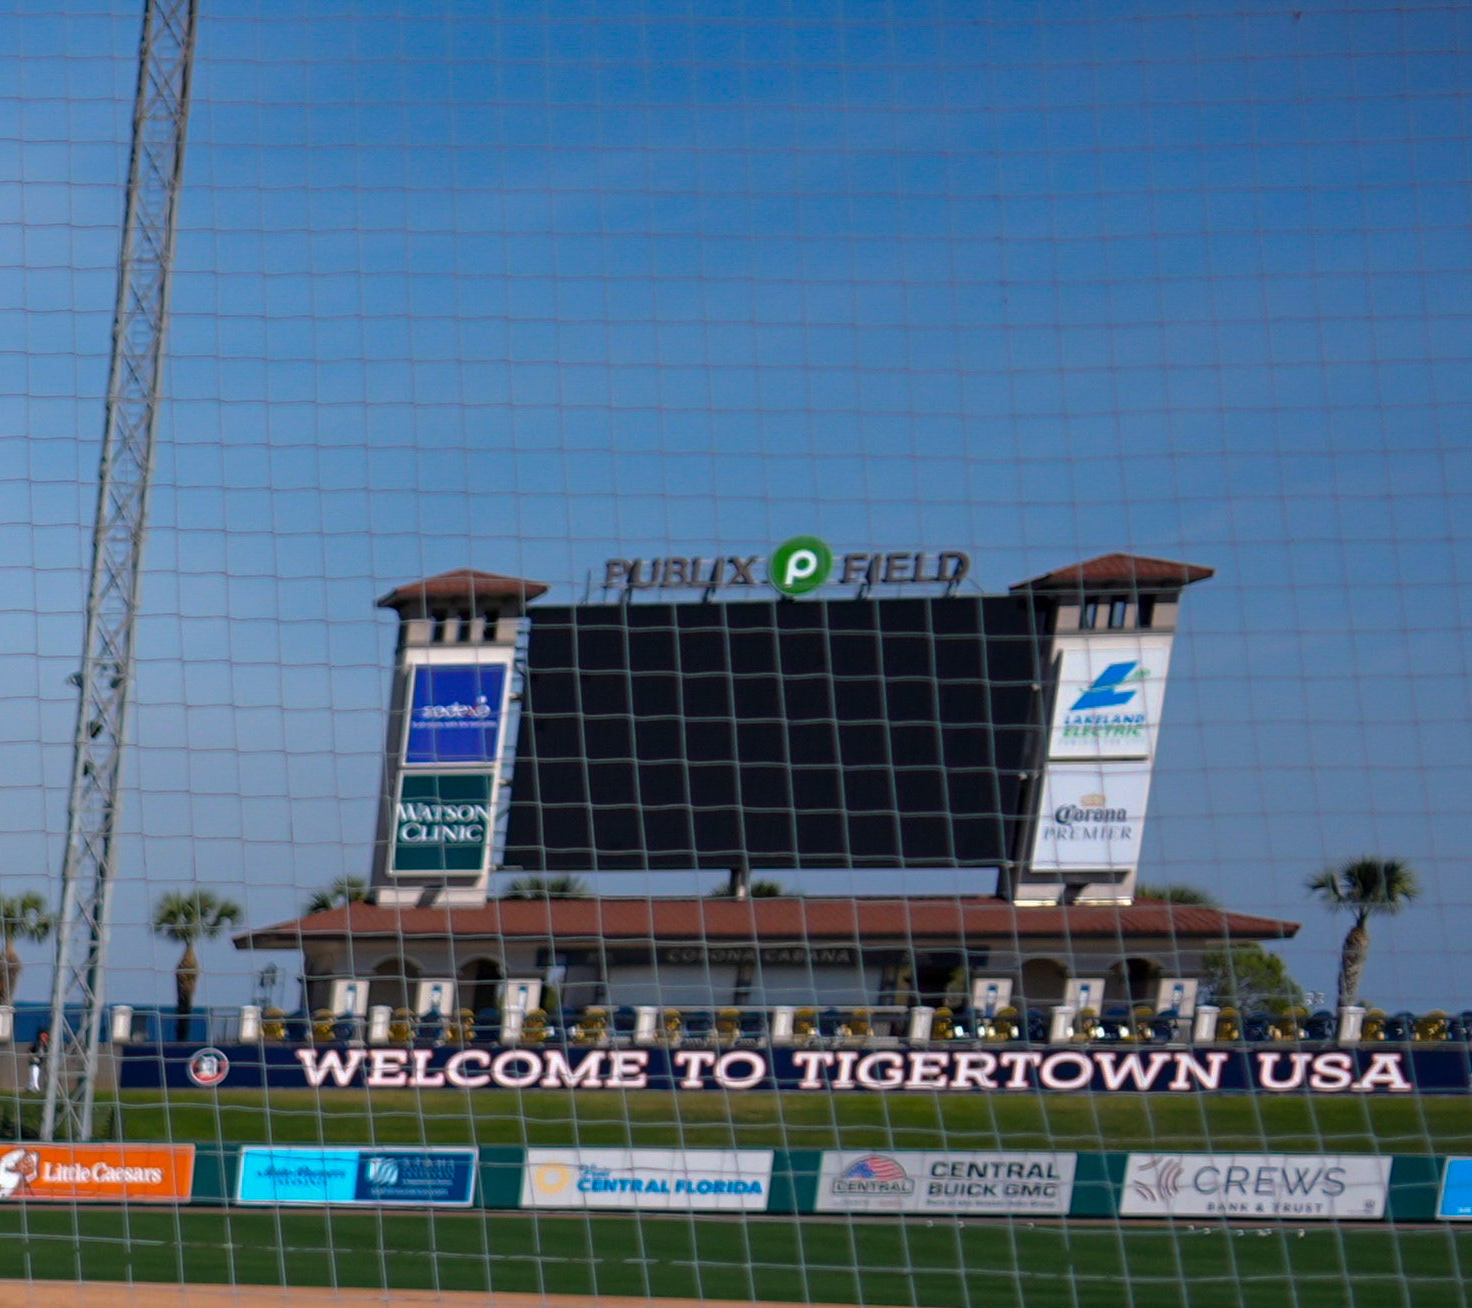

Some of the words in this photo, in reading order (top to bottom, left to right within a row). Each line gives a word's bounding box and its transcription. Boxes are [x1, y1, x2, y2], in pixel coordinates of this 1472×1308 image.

[604, 556, 758, 588] PUBLIX
[842, 551, 971, 585] FIELD
[1063, 714, 1146, 725] LAKELAND
[1062, 725, 1145, 738] ELECTRIC
[397, 802, 491, 823] WATSON
[1055, 804, 1128, 827] Corona
[400, 824, 484, 842] CLINIC
[1043, 826, 1132, 841] PREMIER
[296, 1048, 649, 1089] WELCOME
[675, 1050, 768, 1089] TO
[793, 1051, 1228, 1091] TIGERTOWN
[1257, 1052, 1412, 1092] USA
[43, 1161, 90, 1184] Little
[92, 1162, 163, 1185] Caesars
[930, 1160, 1061, 1180] CENTRAL
[577, 1178, 671, 1193] CENTRAL
[675, 1179, 763, 1195] FLORIDA
[836, 1179, 909, 1192] CENTRAL
[1193, 1165, 1348, 1197] CREWS
[928, 1182, 998, 1198] BUICK
[1004, 1183, 1059, 1199] GMC
[1206, 1202, 1248, 1213] BANK
[1273, 1202, 1325, 1214] TRUST
